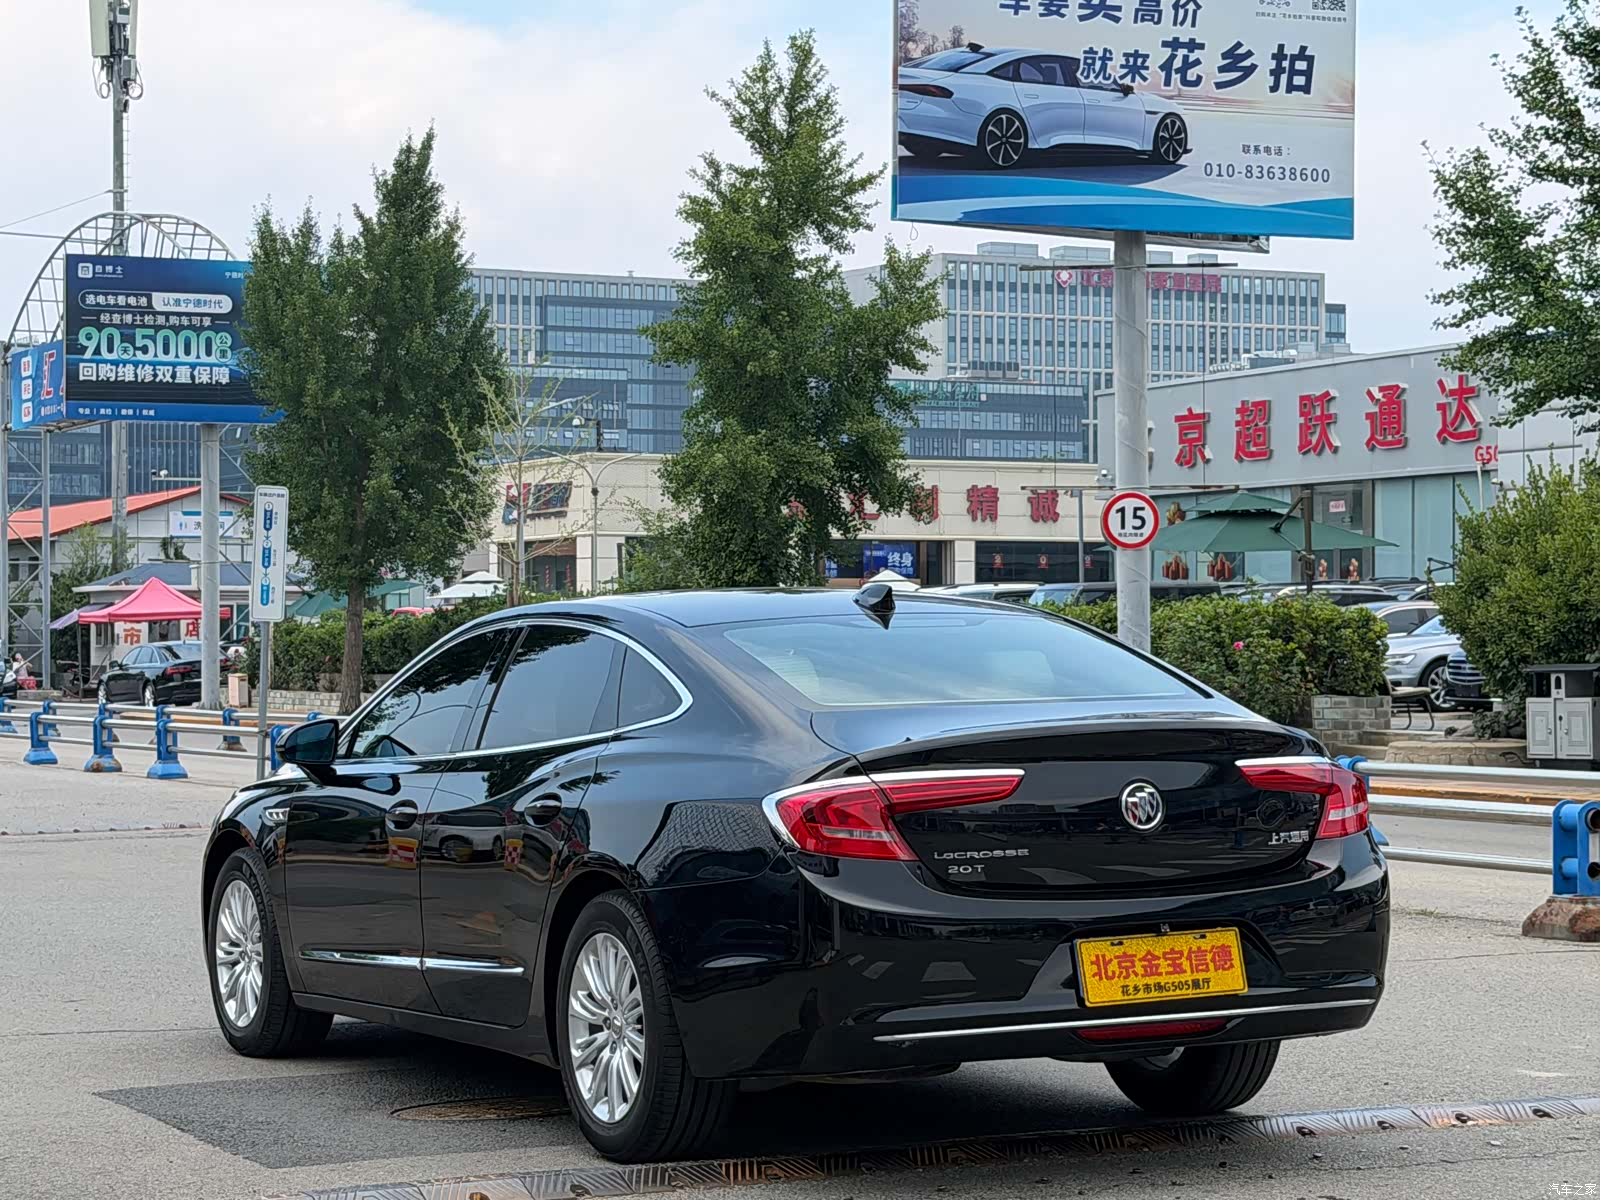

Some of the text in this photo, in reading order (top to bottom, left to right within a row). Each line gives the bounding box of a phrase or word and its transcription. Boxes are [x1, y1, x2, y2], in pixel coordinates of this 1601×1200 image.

[1079, 37, 1316, 96] 就来花乡拍
[1203, 161, 1331, 184] 010-83638600
[85, 294, 223, 309] 选电车看电池 认准宁德时代
[78, 362, 231, 385] 回购维修双重保障
[1147, 374, 1483, 468] 京超跃通达
[1115, 505, 1147, 531] 15
[1090, 944, 1236, 981] 北京金宝信德
[1120, 978, 1212, 997] 花乡市场G505展厅
